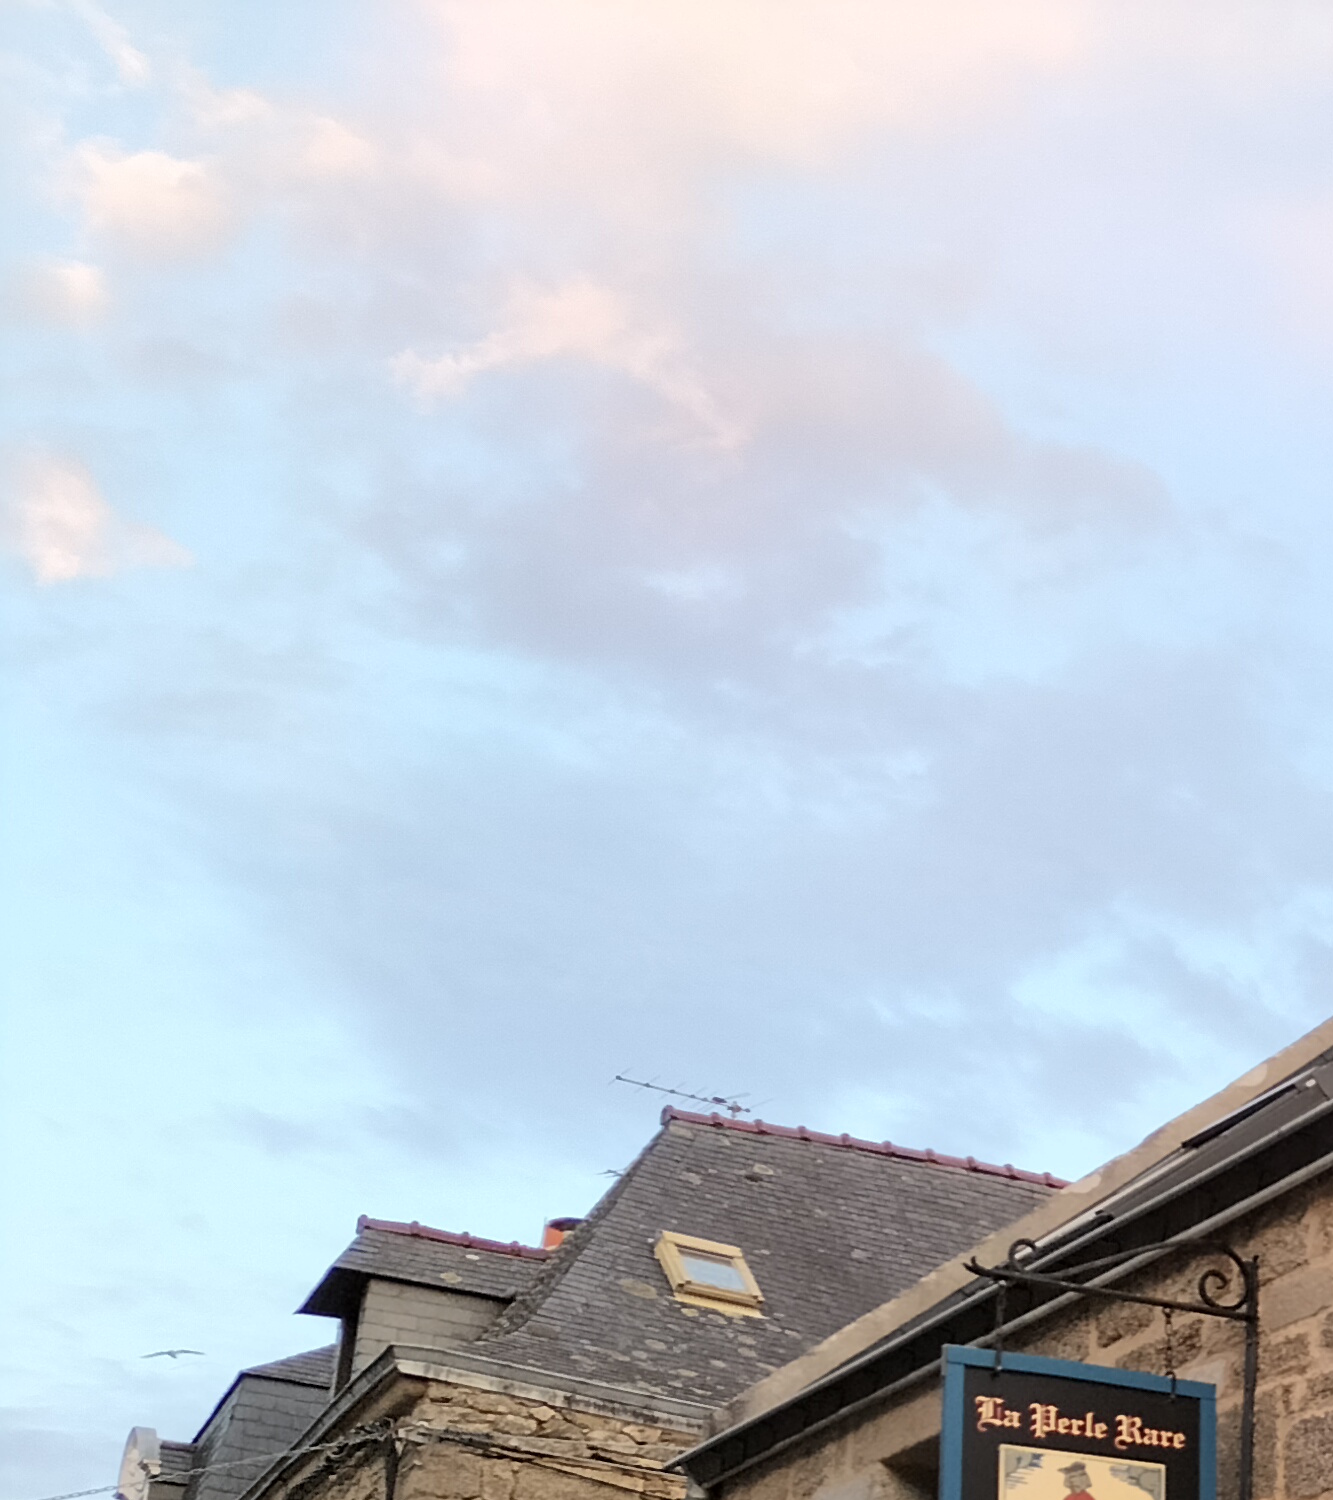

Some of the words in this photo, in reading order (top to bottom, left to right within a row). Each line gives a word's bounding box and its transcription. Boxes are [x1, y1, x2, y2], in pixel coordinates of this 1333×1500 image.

[975, 1395, 1021, 1432] La
[1029, 1403, 1108, 1439] Perle
[1114, 1414, 1187, 1450] Rare
